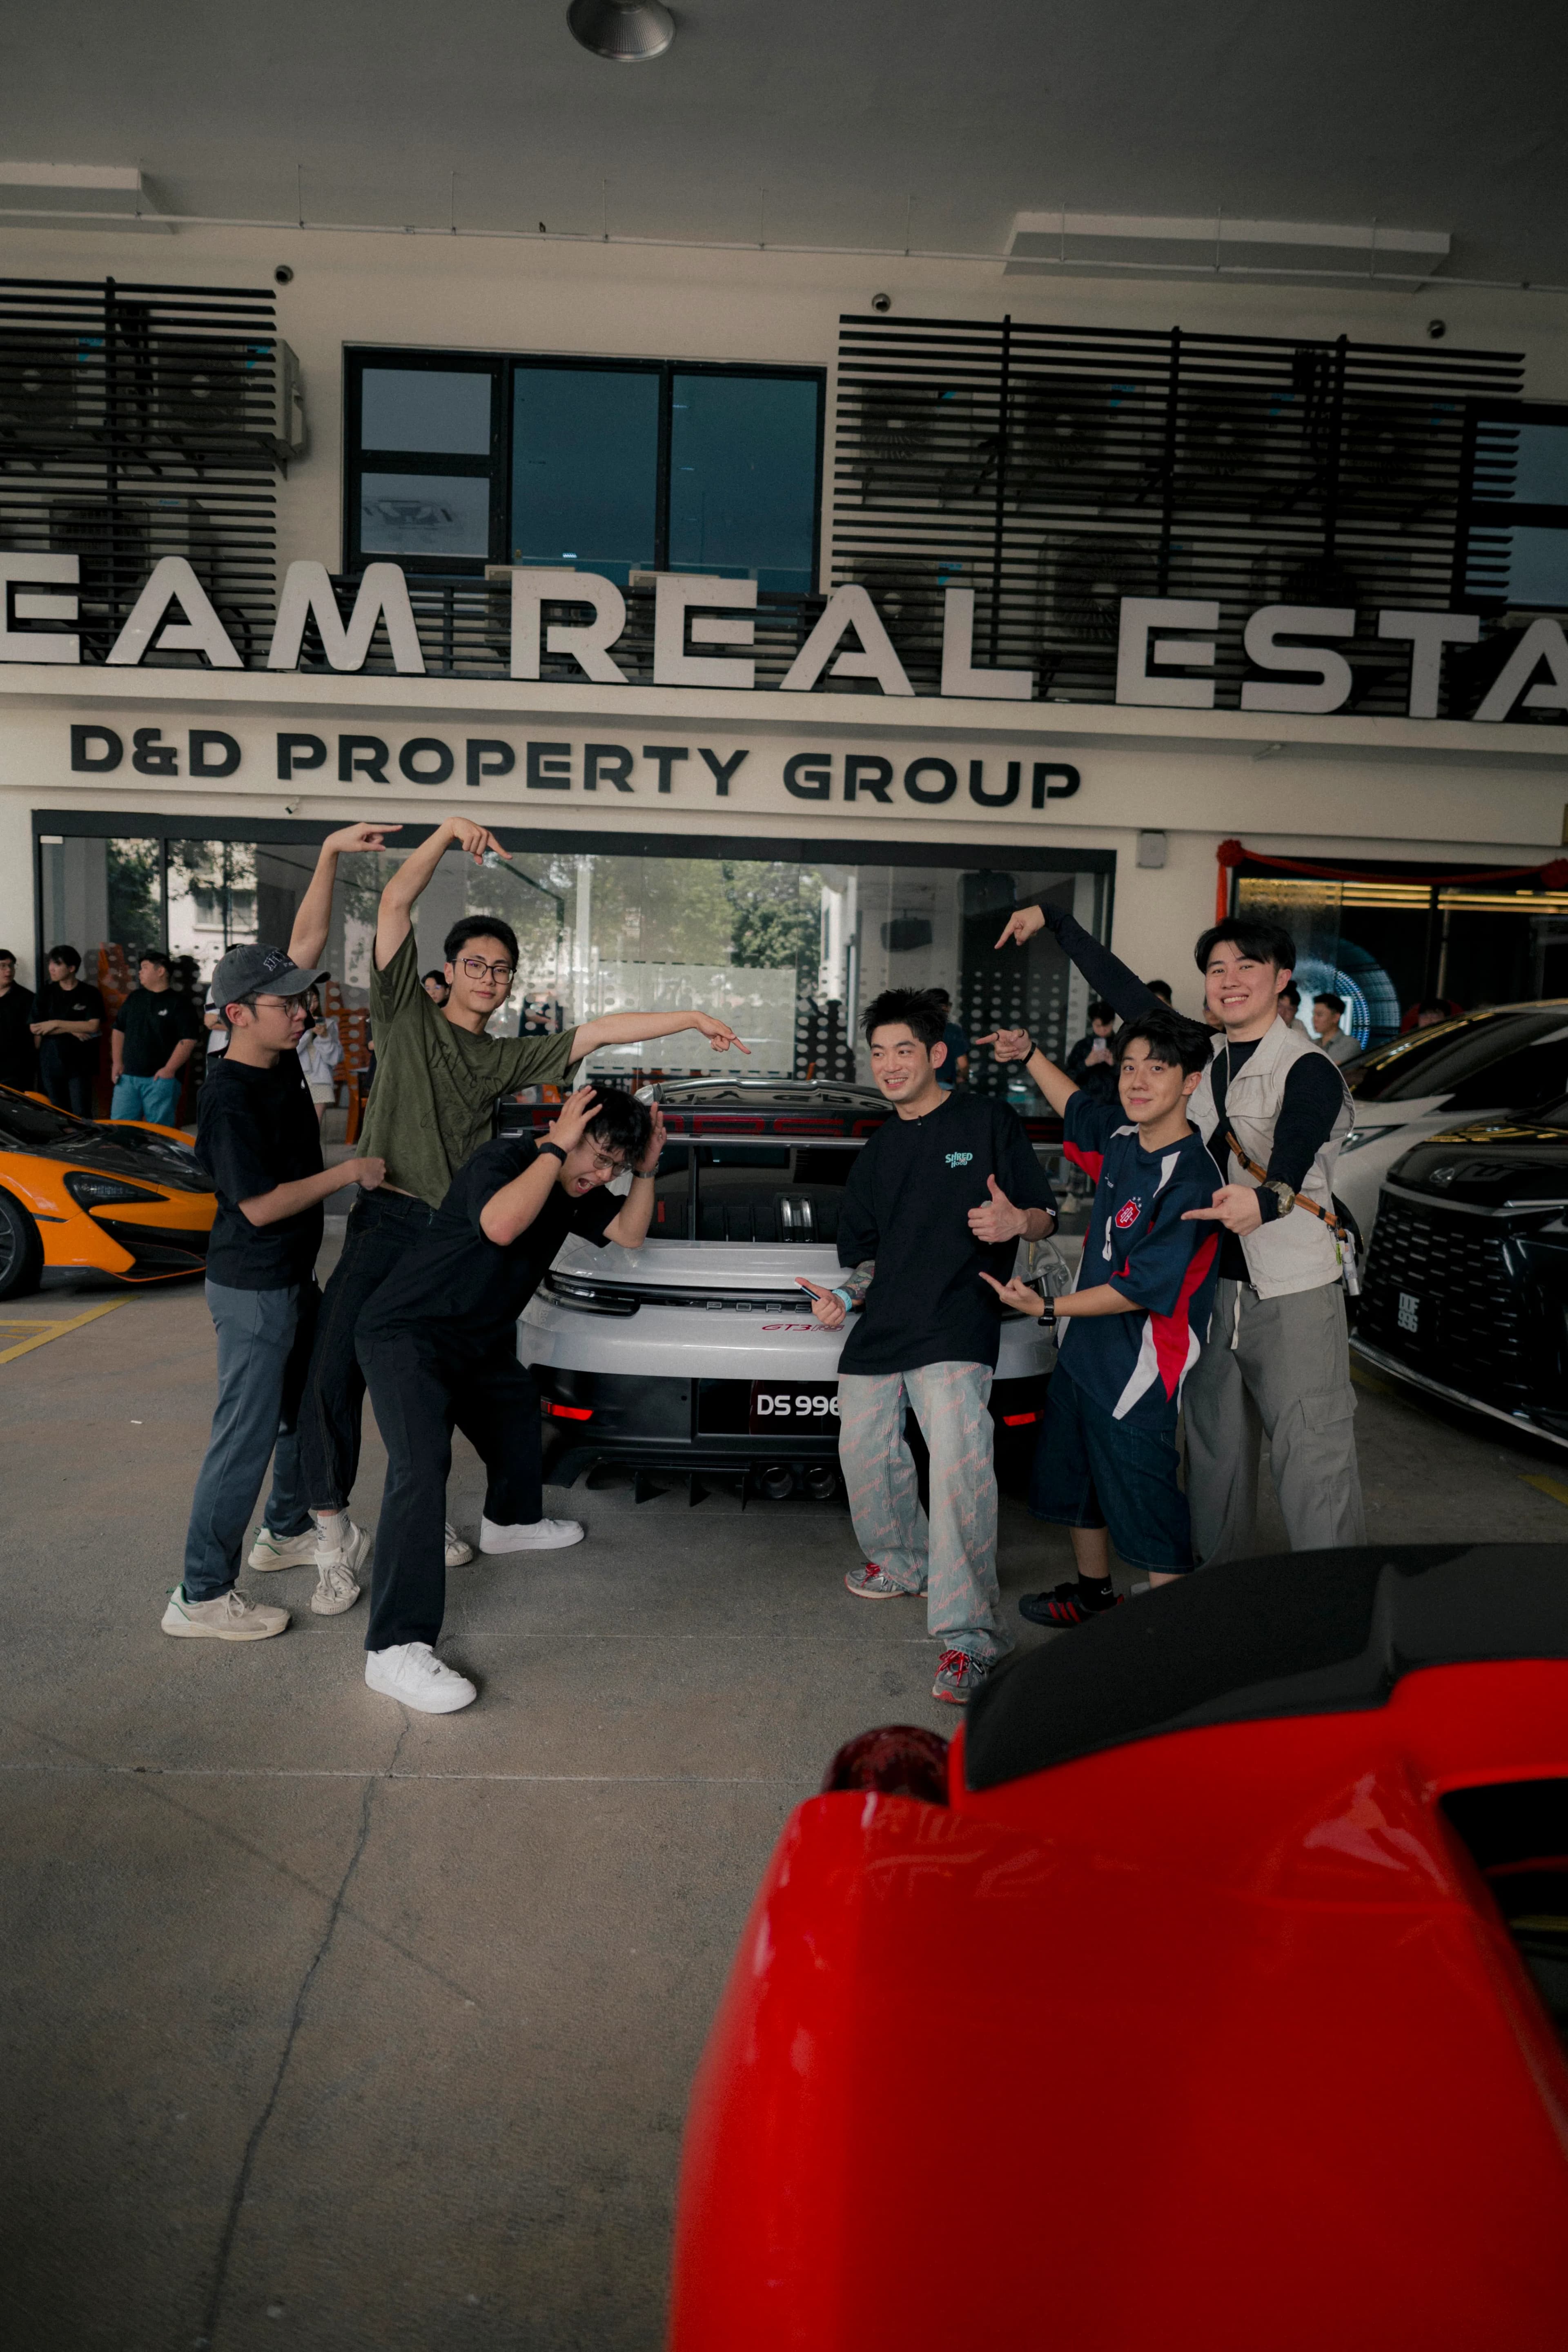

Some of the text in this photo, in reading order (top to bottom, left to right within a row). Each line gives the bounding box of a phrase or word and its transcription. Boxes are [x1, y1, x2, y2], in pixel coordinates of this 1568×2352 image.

[0, 552, 1568, 722] EAM REAL ESTA
[70, 724, 1081, 809] D&D PROPERTY GROUP
[945, 1152, 973, 1163] SHRED
[1398, 1310, 1418, 1333] 996
[757, 1395, 791, 1416] DS
